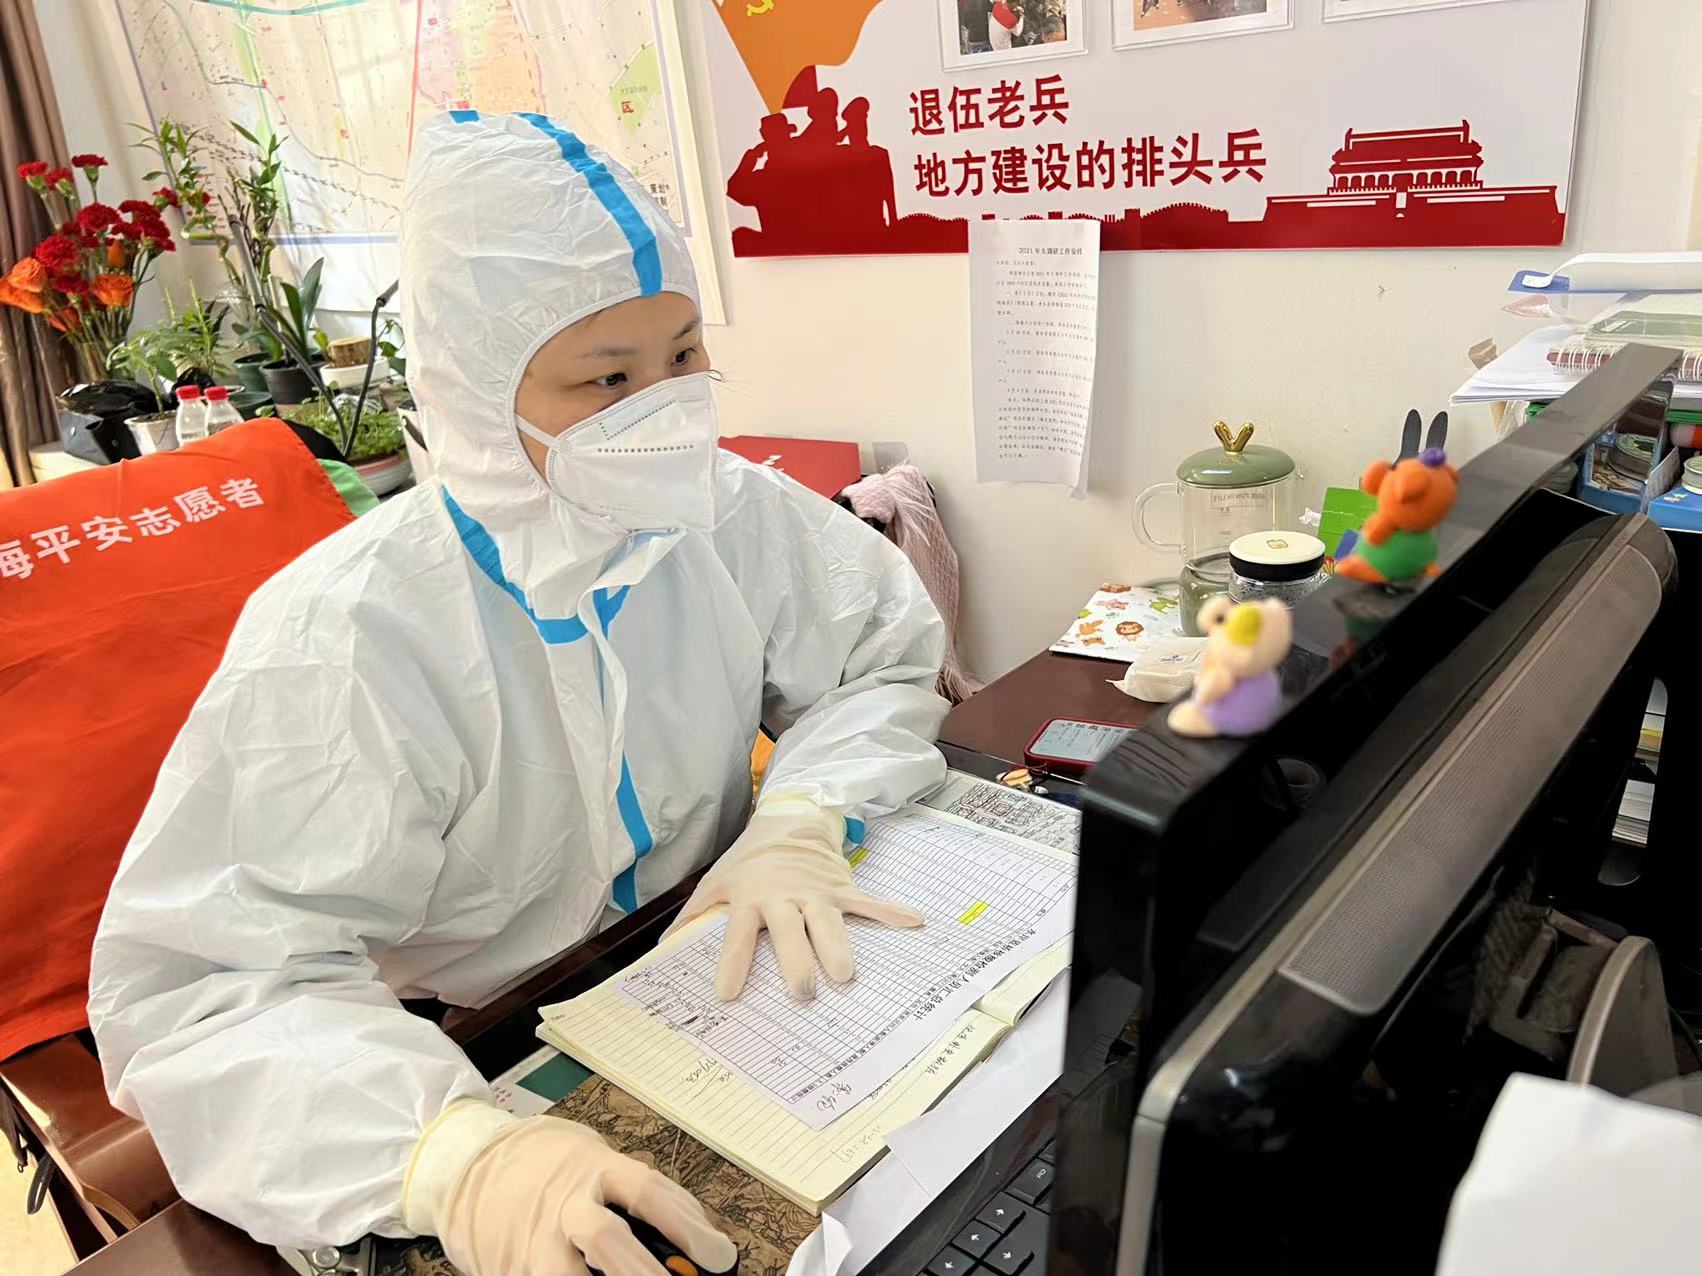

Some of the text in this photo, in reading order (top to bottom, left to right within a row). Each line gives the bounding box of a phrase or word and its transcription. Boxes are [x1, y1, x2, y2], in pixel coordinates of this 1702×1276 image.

[909, 74, 1070, 136] 退伍老兵
[914, 128, 1267, 198] 地方建设的排头兵
